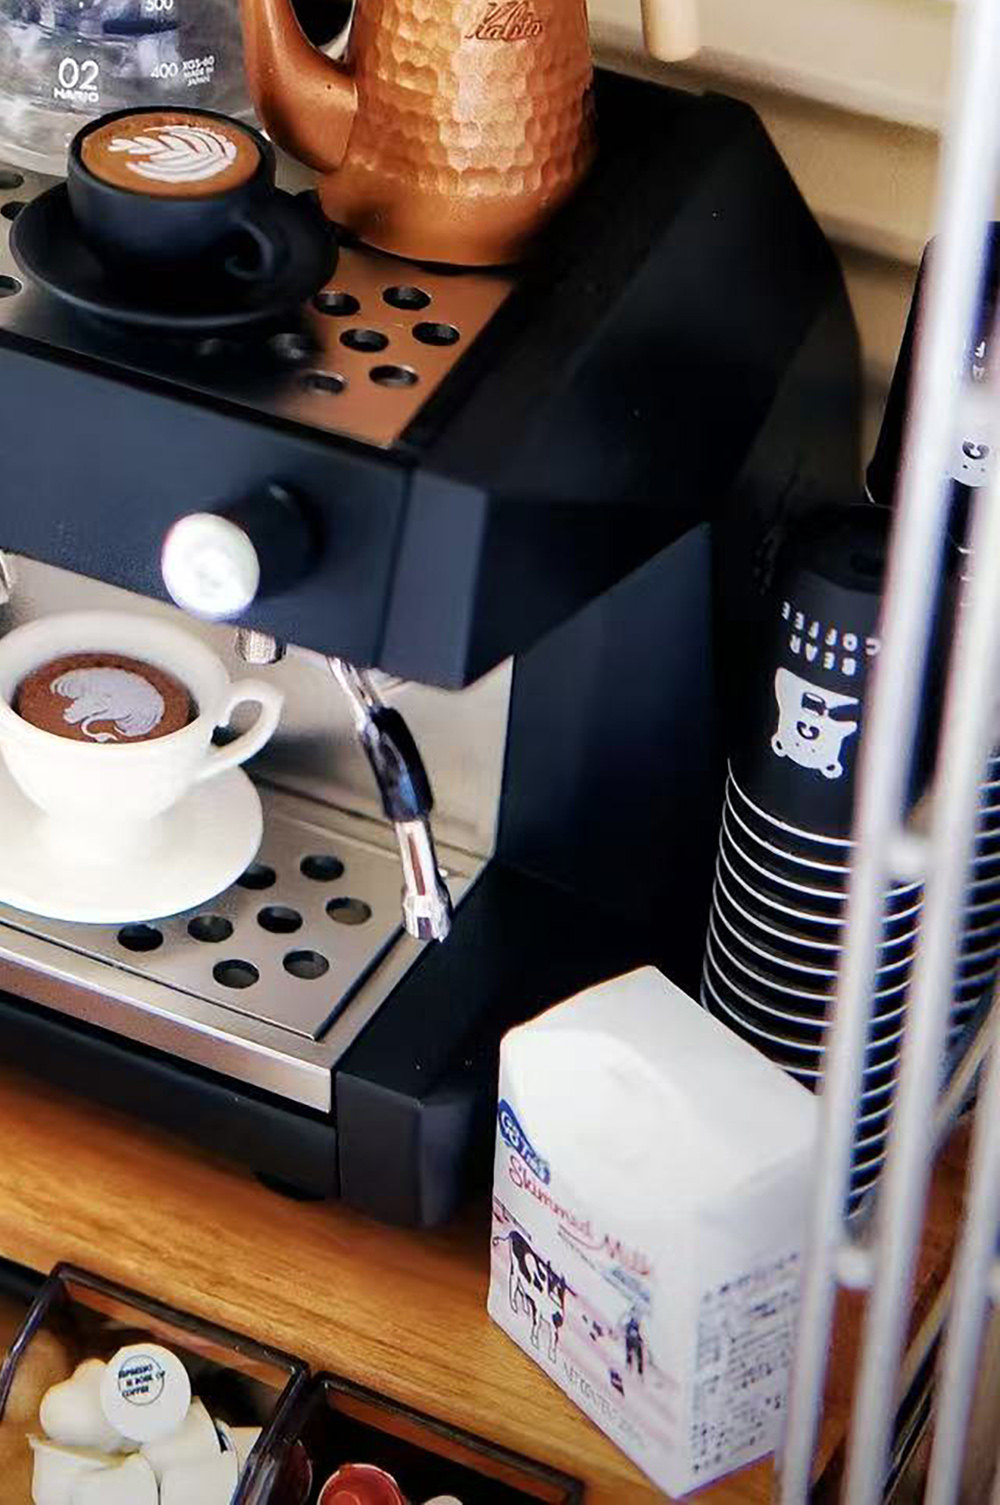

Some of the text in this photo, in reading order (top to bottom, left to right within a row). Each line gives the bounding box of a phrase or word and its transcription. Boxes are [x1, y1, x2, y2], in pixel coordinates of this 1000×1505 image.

[464, 0, 543, 42] Kalita
[58, 57, 99, 91] 02
[150, 62, 179, 79] 400
[781, 601, 881, 656] COFFEE
[789, 634, 857, 676] BEAR
